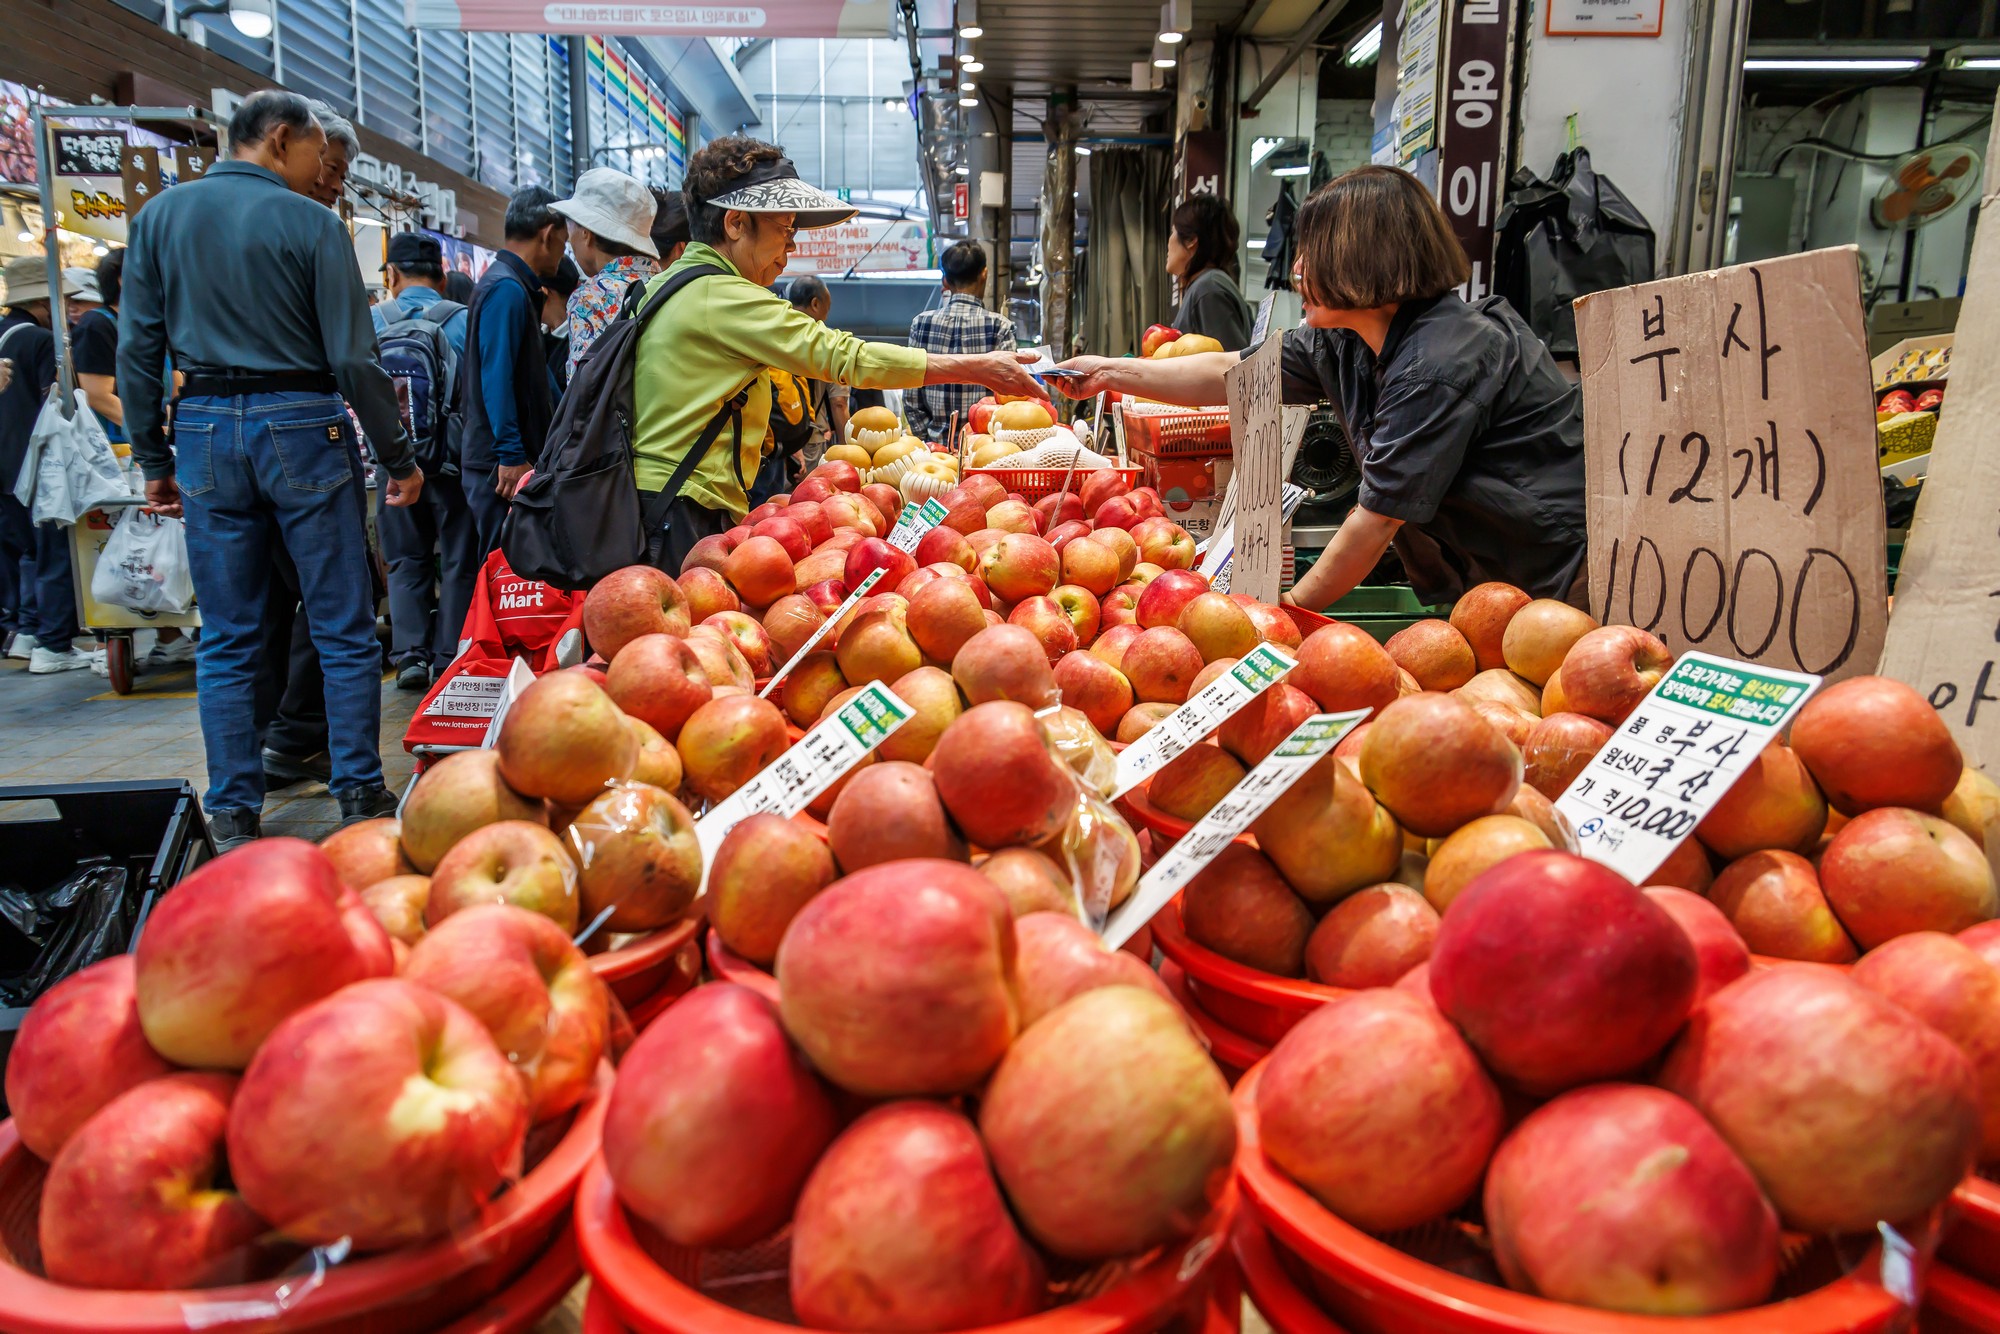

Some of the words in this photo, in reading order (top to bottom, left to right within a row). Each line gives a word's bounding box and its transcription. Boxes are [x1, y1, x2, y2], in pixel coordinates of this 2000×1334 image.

[1630, 267, 1782, 401] 부사
[1619, 420, 1826, 516] (12개)
[499, 591, 544, 610] Mart
[501, 581, 545, 594] LOTTE
[1602, 536, 1861, 675] 10,000
[449, 681, 481, 692] 물가안정
[447, 701, 480, 712] 동반성장
[1602, 746, 1651, 776] 원산지
[1607, 795, 1697, 841] 10,000
